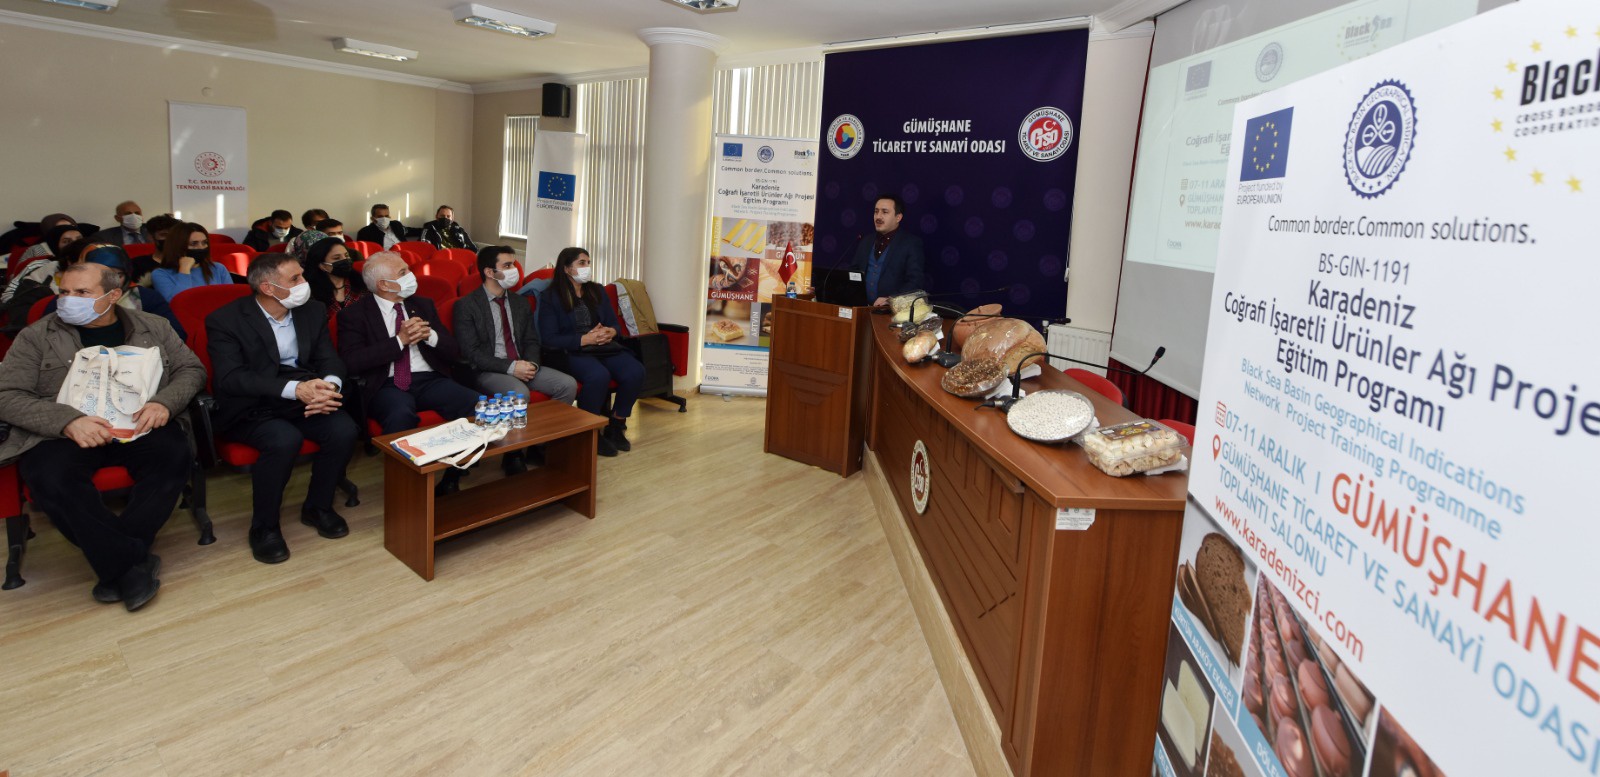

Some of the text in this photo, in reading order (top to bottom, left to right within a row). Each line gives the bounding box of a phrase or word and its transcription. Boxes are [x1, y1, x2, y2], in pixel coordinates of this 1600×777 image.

[903, 119, 971, 136] GÜMÜŞHANE
[1351, 107, 1366, 134] BASIN
[1516, 110, 1553, 124] CROSS
[873, 138, 1005, 153] TİCARET VE SANAYİ ODASI
[1186, 134, 1214, 148] Coğrafi
[718, 188, 738, 196] Coğrafi
[743, 197, 761, 205] Eğitim
[1237, 194, 1282, 205] EUROPEAN UNION
[1239, 184, 1256, 194] Project
[1257, 182, 1276, 192] funded
[1269, 215, 1537, 245] Common border.Common solutions.
[1318, 253, 1411, 285] BS-GIN-1191
[711, 291, 754, 300] GÜMÜŞHANE
[1308, 280, 1416, 330] Karadeniz
[1225, 292, 1267, 322] Coğrafi
[1270, 298, 1326, 344] İşaretli
[1332, 314, 1421, 374] Ürünler
[1427, 348, 1477, 400] Ağı
[1277, 338, 1444, 432] Eğitim Programı
[1242, 358, 1526, 516] Black Sea Basin Geographical Indications
[1245, 380, 1502, 541] Network Project Training Programme
[1220, 464, 1326, 577] TOPLANTI SALONU
[1226, 410, 1256, 447] 07-11
[1258, 434, 1306, 485] ARALIK
[1332, 473, 1600, 704] GÜMÜŞHANE
[1215, 495, 1365, 663] www.karadenizci.com
[1222, 441, 1600, 776] GÜMÜŞHANE TİCARET VE SANAYİ ODASI
